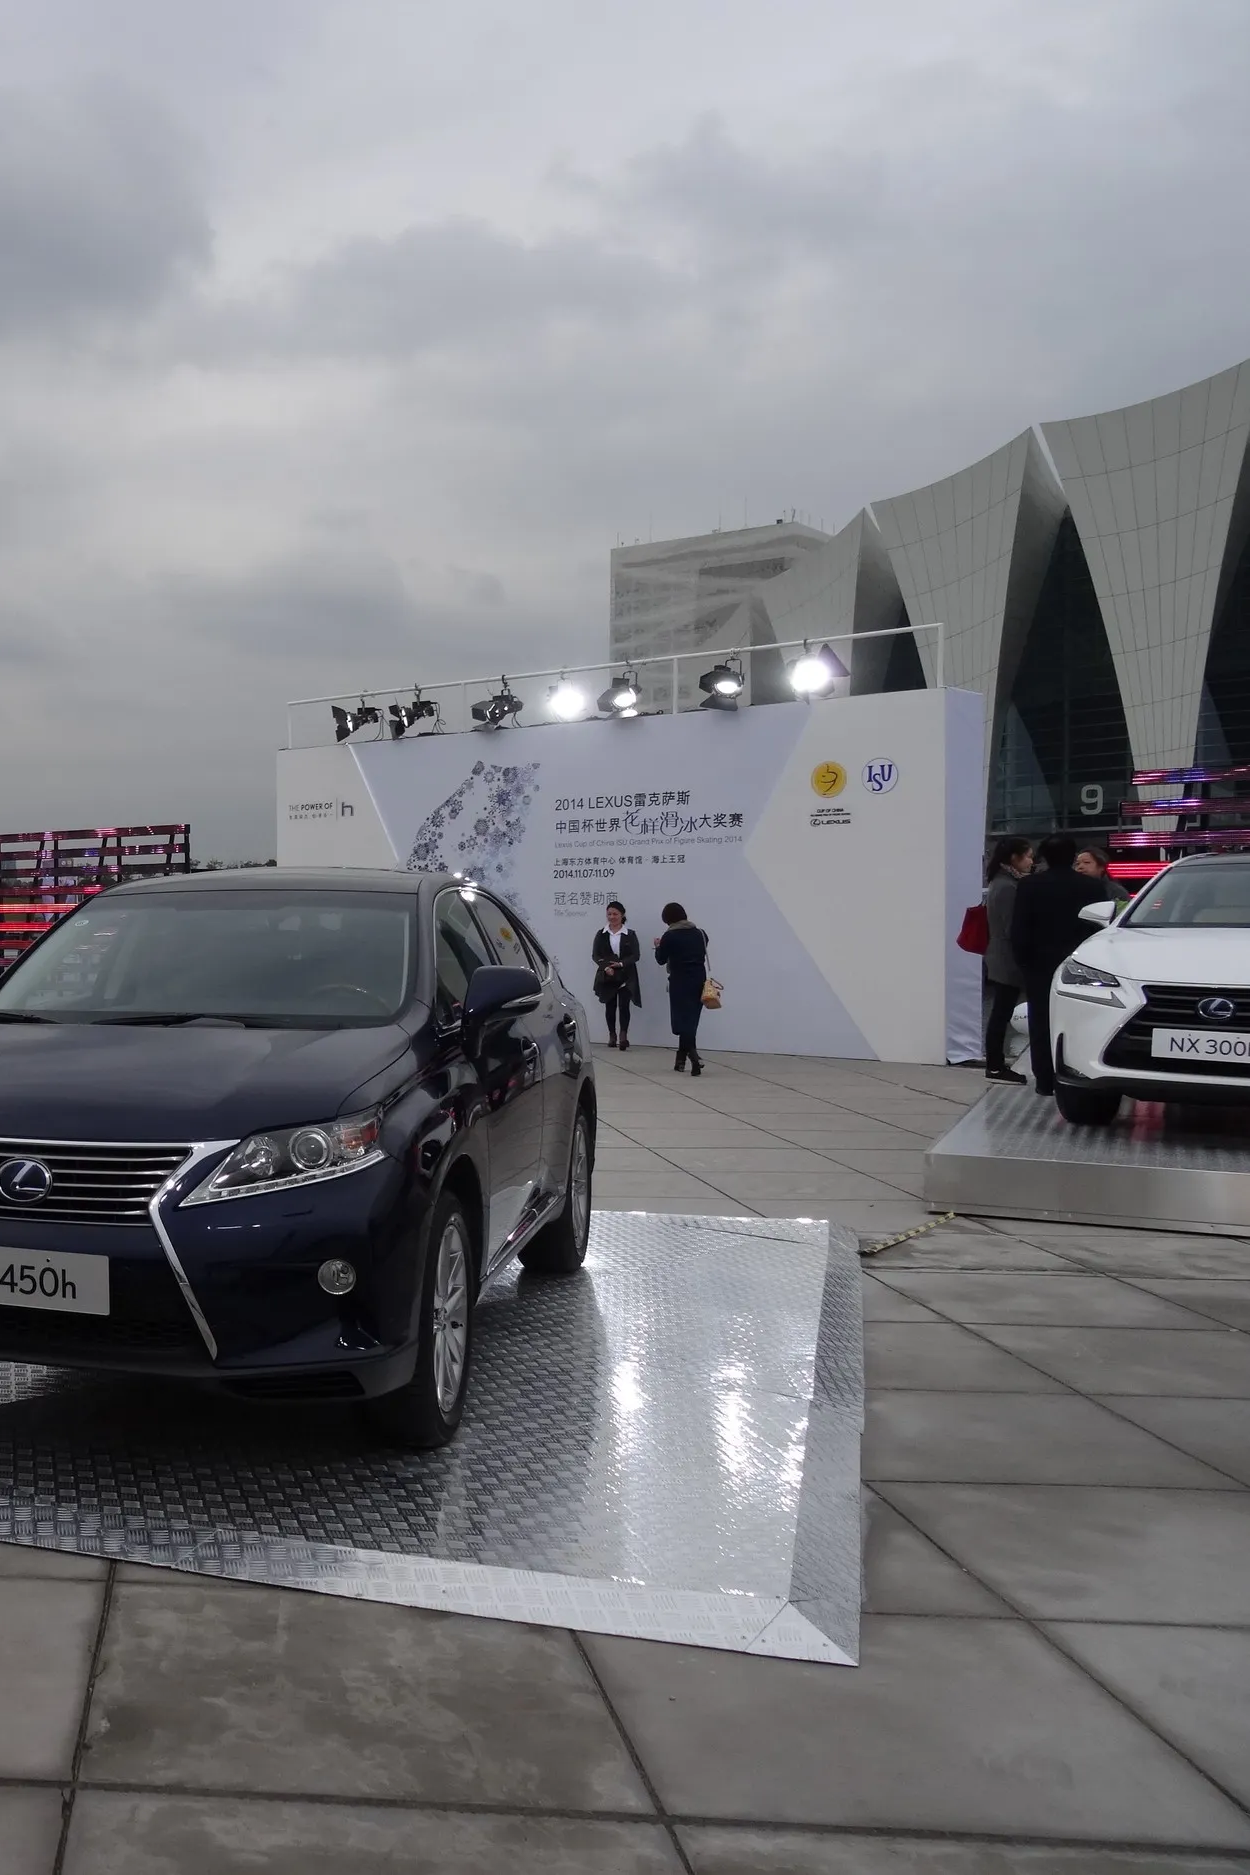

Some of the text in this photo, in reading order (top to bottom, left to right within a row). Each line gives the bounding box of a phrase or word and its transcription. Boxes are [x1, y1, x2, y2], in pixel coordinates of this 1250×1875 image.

[866, 764, 893, 792] ISU
[301, 803, 323, 811] POWER
[324, 802, 333, 810] OF
[341, 802, 354, 817] h
[555, 798, 584, 811] 2014
[1080, 784, 1104, 815] 9
[555, 809, 744, 837] 中国杯世界花样滑冰大奖赛
[574, 840, 587, 848] Cup
[629, 838, 650, 846] Grand
[651, 837, 663, 845] Prix
[673, 836, 695, 846] Figure
[696, 835, 723, 845] Skating
[724, 835, 743, 843] 2014
[1169, 1036, 1250, 1057] NX 300
